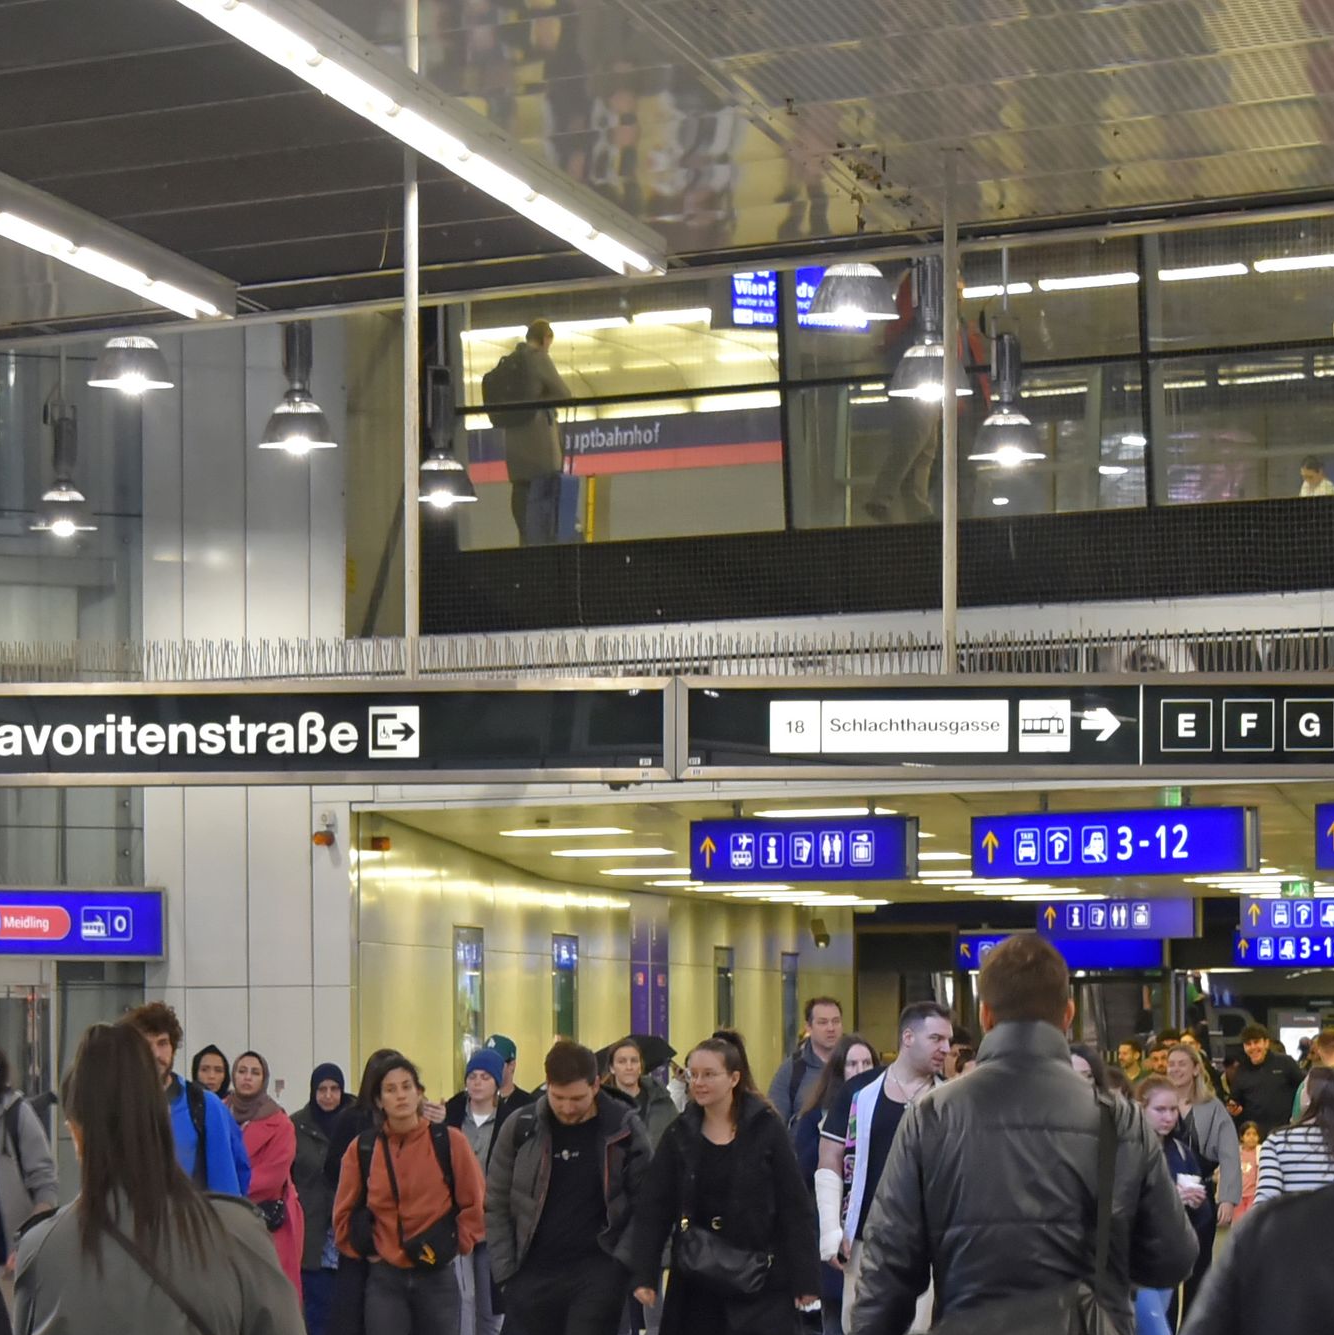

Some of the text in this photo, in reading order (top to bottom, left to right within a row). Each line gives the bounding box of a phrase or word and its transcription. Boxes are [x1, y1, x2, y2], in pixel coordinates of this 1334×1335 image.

[564, 421, 661, 453] auptbahnhof
[785, 717, 1001, 736] 18 Schlachthausgasse
[1177, 713, 1196, 737] E
[1241, 713, 1257, 737] F
[1298, 712, 1320, 737] G
[3, 915, 50, 932] Meidling
